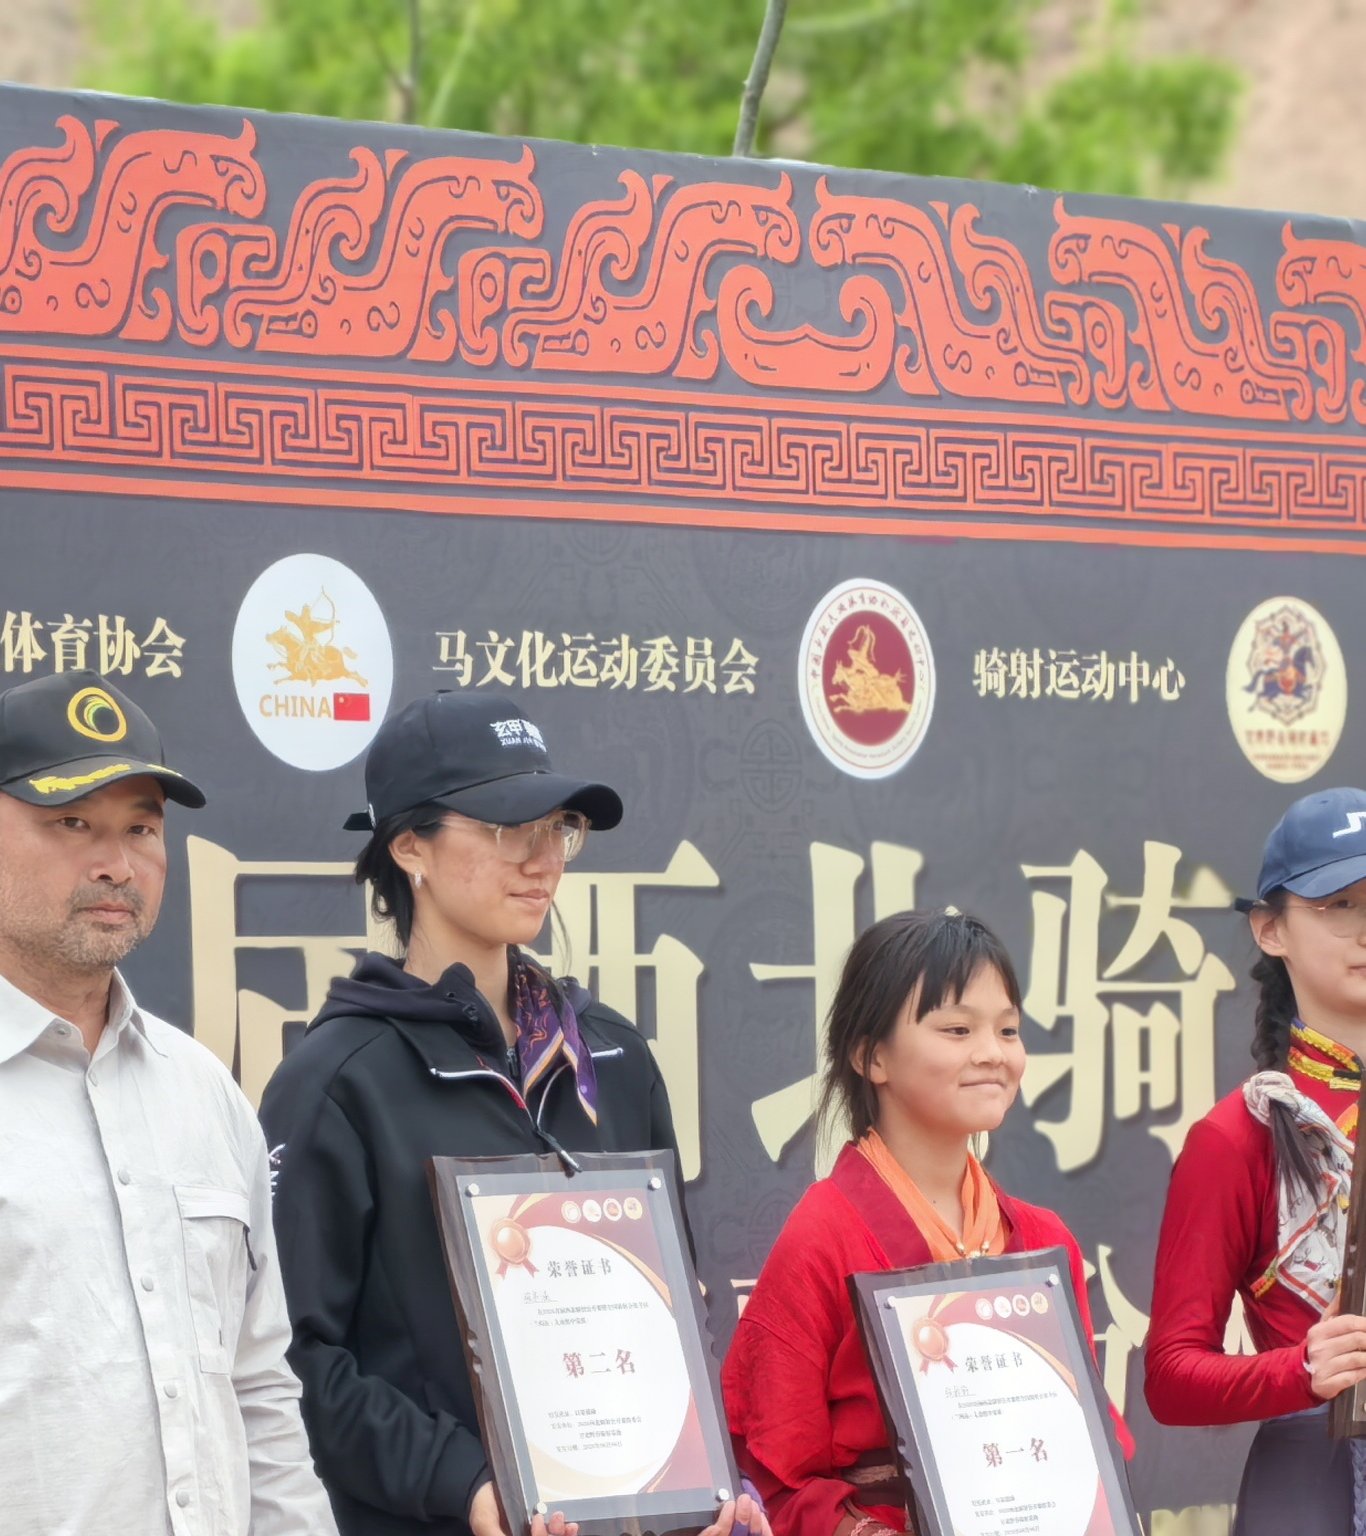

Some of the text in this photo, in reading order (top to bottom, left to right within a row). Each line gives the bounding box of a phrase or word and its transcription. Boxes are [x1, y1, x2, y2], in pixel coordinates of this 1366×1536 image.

[432, 631, 759, 697] 马文化运动委员会
[972, 648, 1187, 704] 骑射运动中心
[259, 694, 332, 721] CHINA
[547, 1258, 613, 1279] 荣誉证书
[562, 1347, 636, 1379] 第二名
[964, 1351, 1024, 1374] 荣誉证书
[982, 1436, 1049, 1469] 第一名
